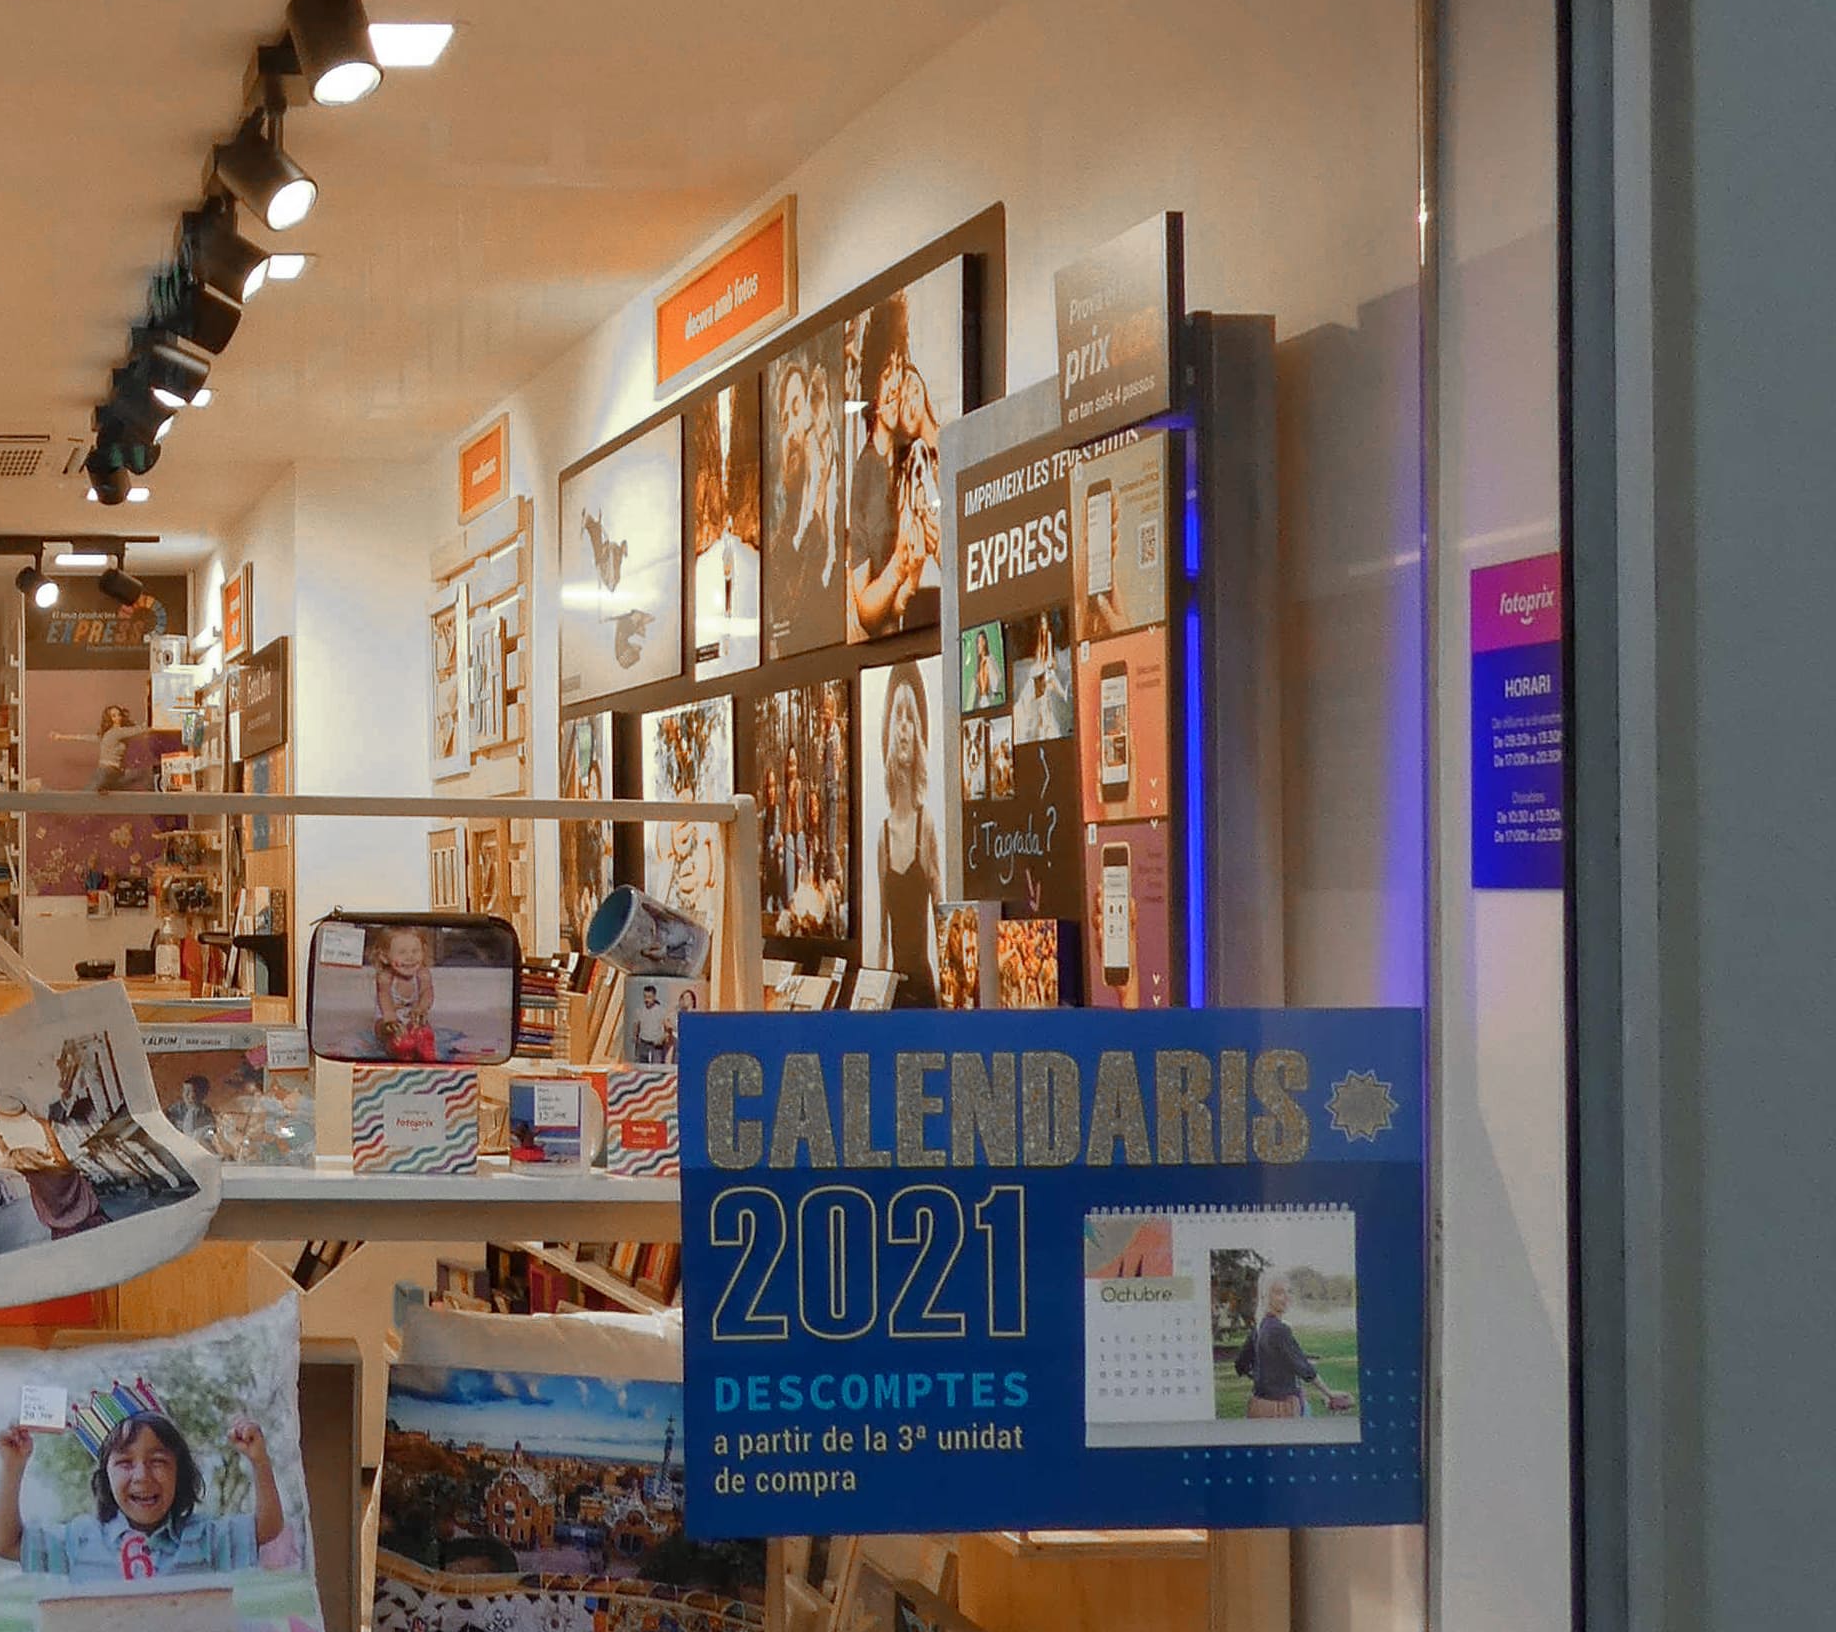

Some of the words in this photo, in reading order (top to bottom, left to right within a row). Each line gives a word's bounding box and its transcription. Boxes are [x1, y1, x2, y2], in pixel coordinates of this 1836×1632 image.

[965, 467, 1024, 517] IMPRIMEIX
[1026, 458, 1049, 492] LES
[967, 509, 1068, 593] EXPRESS
[1499, 584, 1555, 616] fotoprix
[1505, 674, 1551, 698] HORARI
[705, 1050, 1311, 1170] CALENDARIS
[710, 1184, 1027, 1341] 2021
[1100, 1286, 1173, 1303] Octubre
[714, 1371, 1030, 1413] DESCOMPTES
[714, 1434, 729, 1455] a
[738, 1426, 812, 1461] partir
[821, 1425, 855, 1453] de
[865, 1424, 888, 1452] la
[937, 1422, 1024, 1451] unidat
[715, 1467, 747, 1495] de
[755, 1469, 857, 1499] compra
